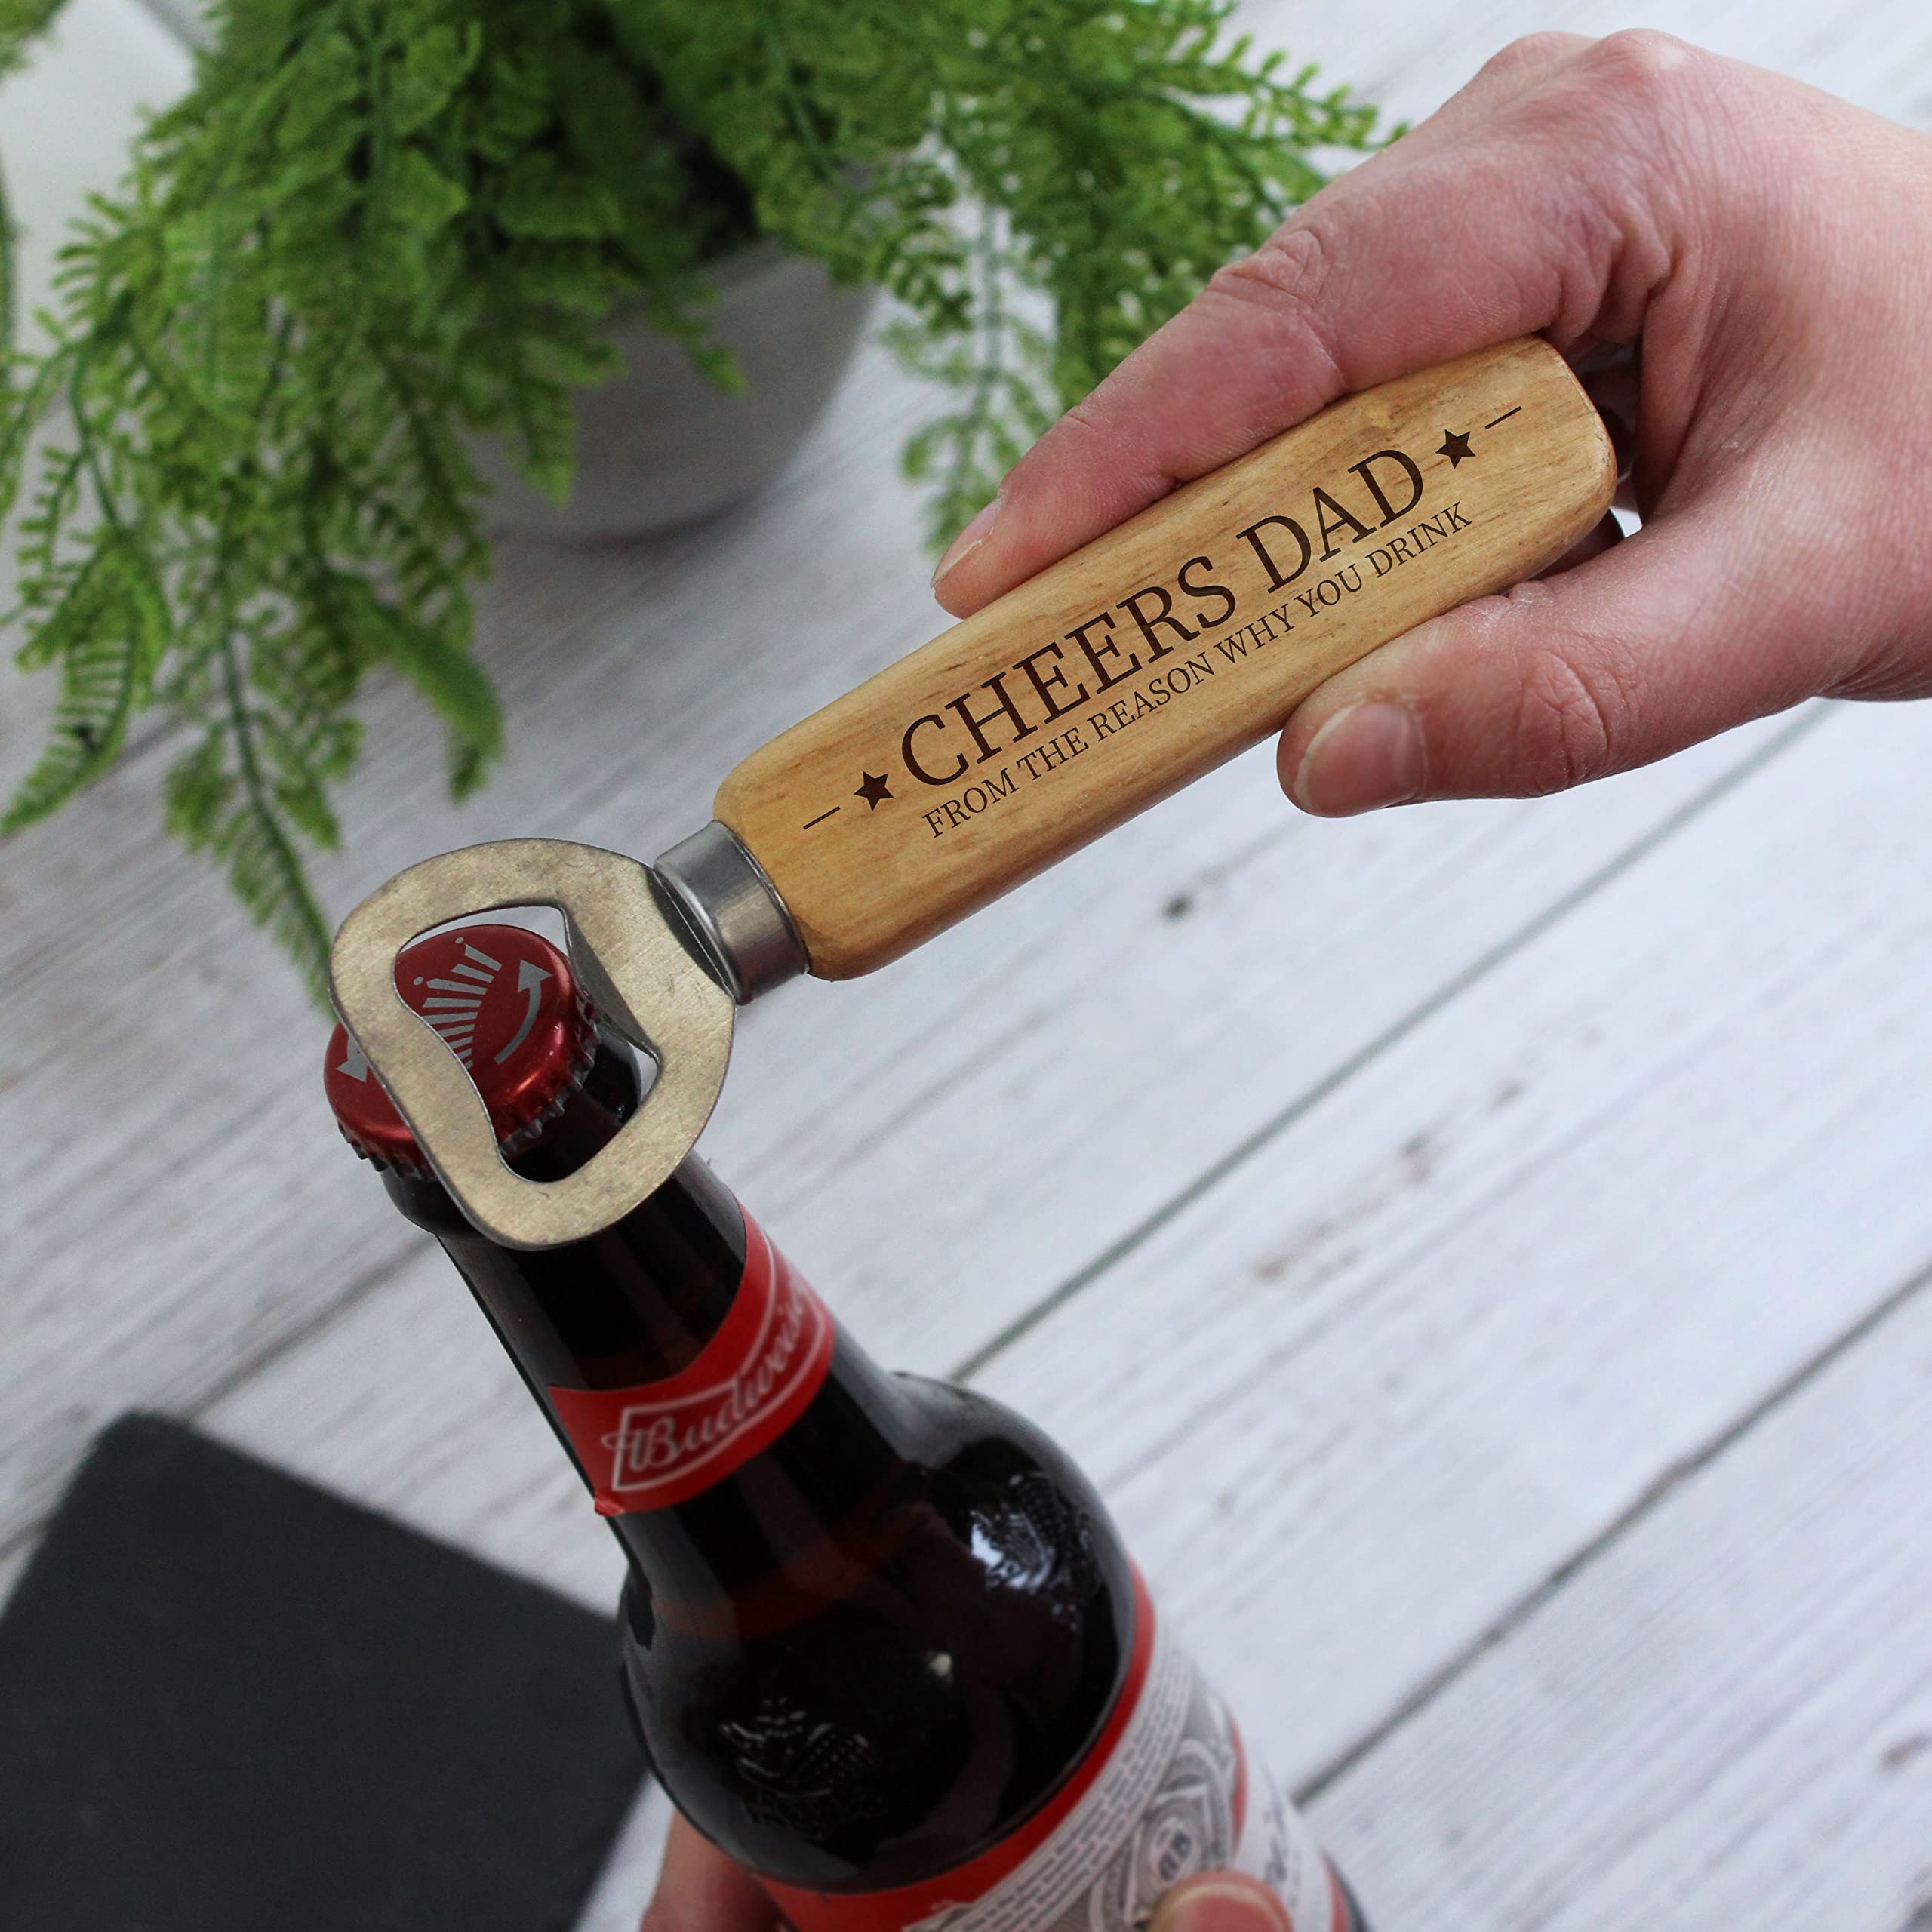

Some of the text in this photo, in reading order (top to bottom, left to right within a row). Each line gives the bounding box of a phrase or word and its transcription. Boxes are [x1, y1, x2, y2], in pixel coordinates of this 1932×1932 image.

[901, 449, 1424, 786] CHEERS DAD
[921, 501, 1474, 839] FROM THE REASON WHY YOU DRINK
